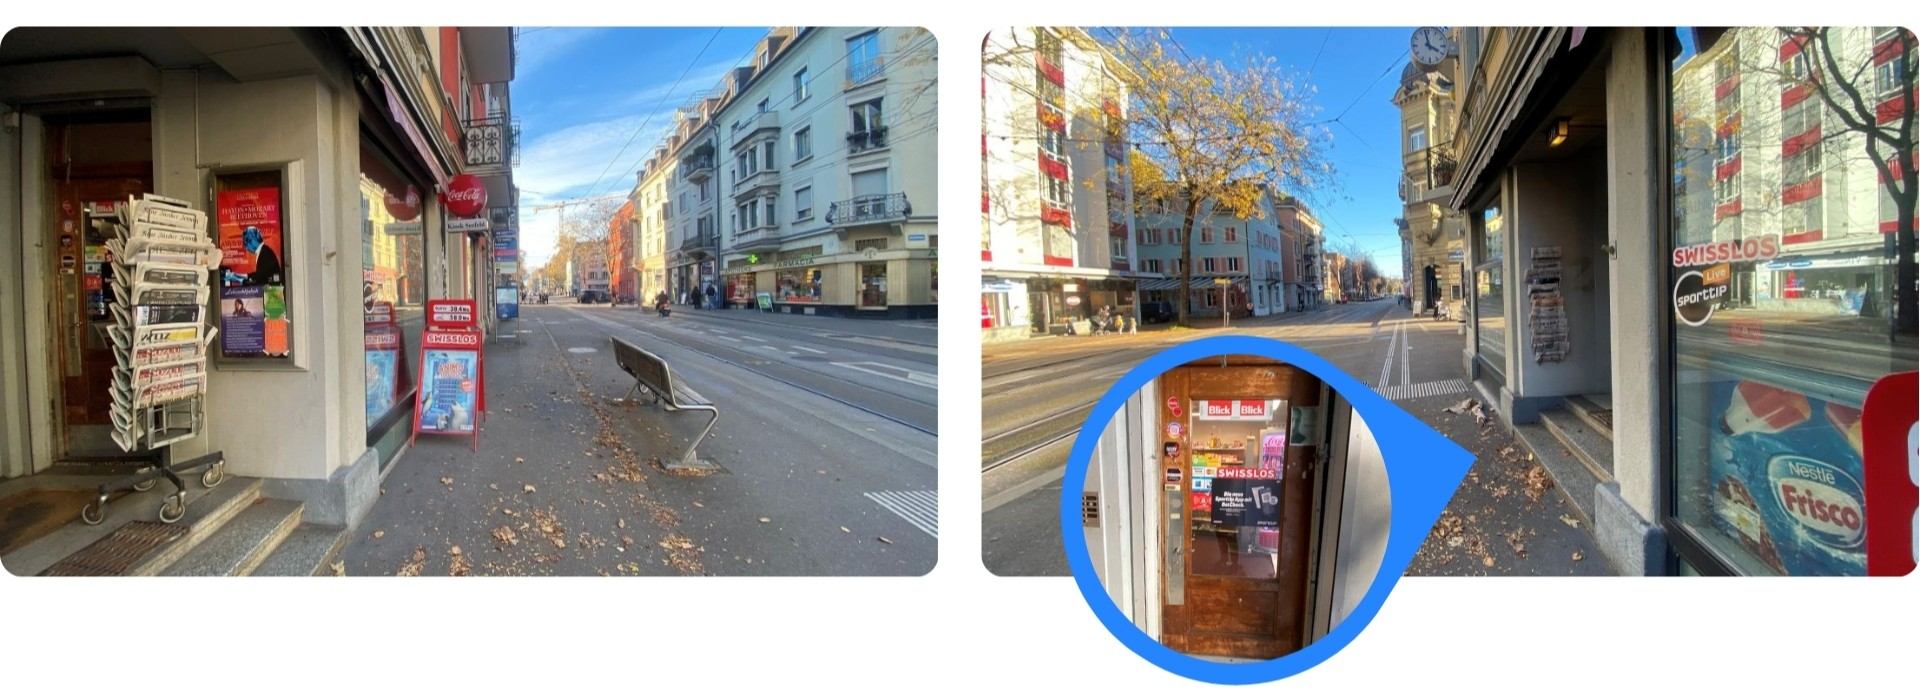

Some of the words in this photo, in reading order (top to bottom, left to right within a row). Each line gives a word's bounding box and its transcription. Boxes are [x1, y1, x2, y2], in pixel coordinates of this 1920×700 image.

[1674, 236, 1777, 266] SWISSLOS
[1706, 269, 1726, 281] Live
[428, 334, 476, 344] SWISSLOS
[1208, 405, 1231, 415] Blick
[1241, 405, 1263, 415] Blick
[1218, 468, 1275, 478] SWISSLOS
[1781, 484, 1861, 531] Frisco
